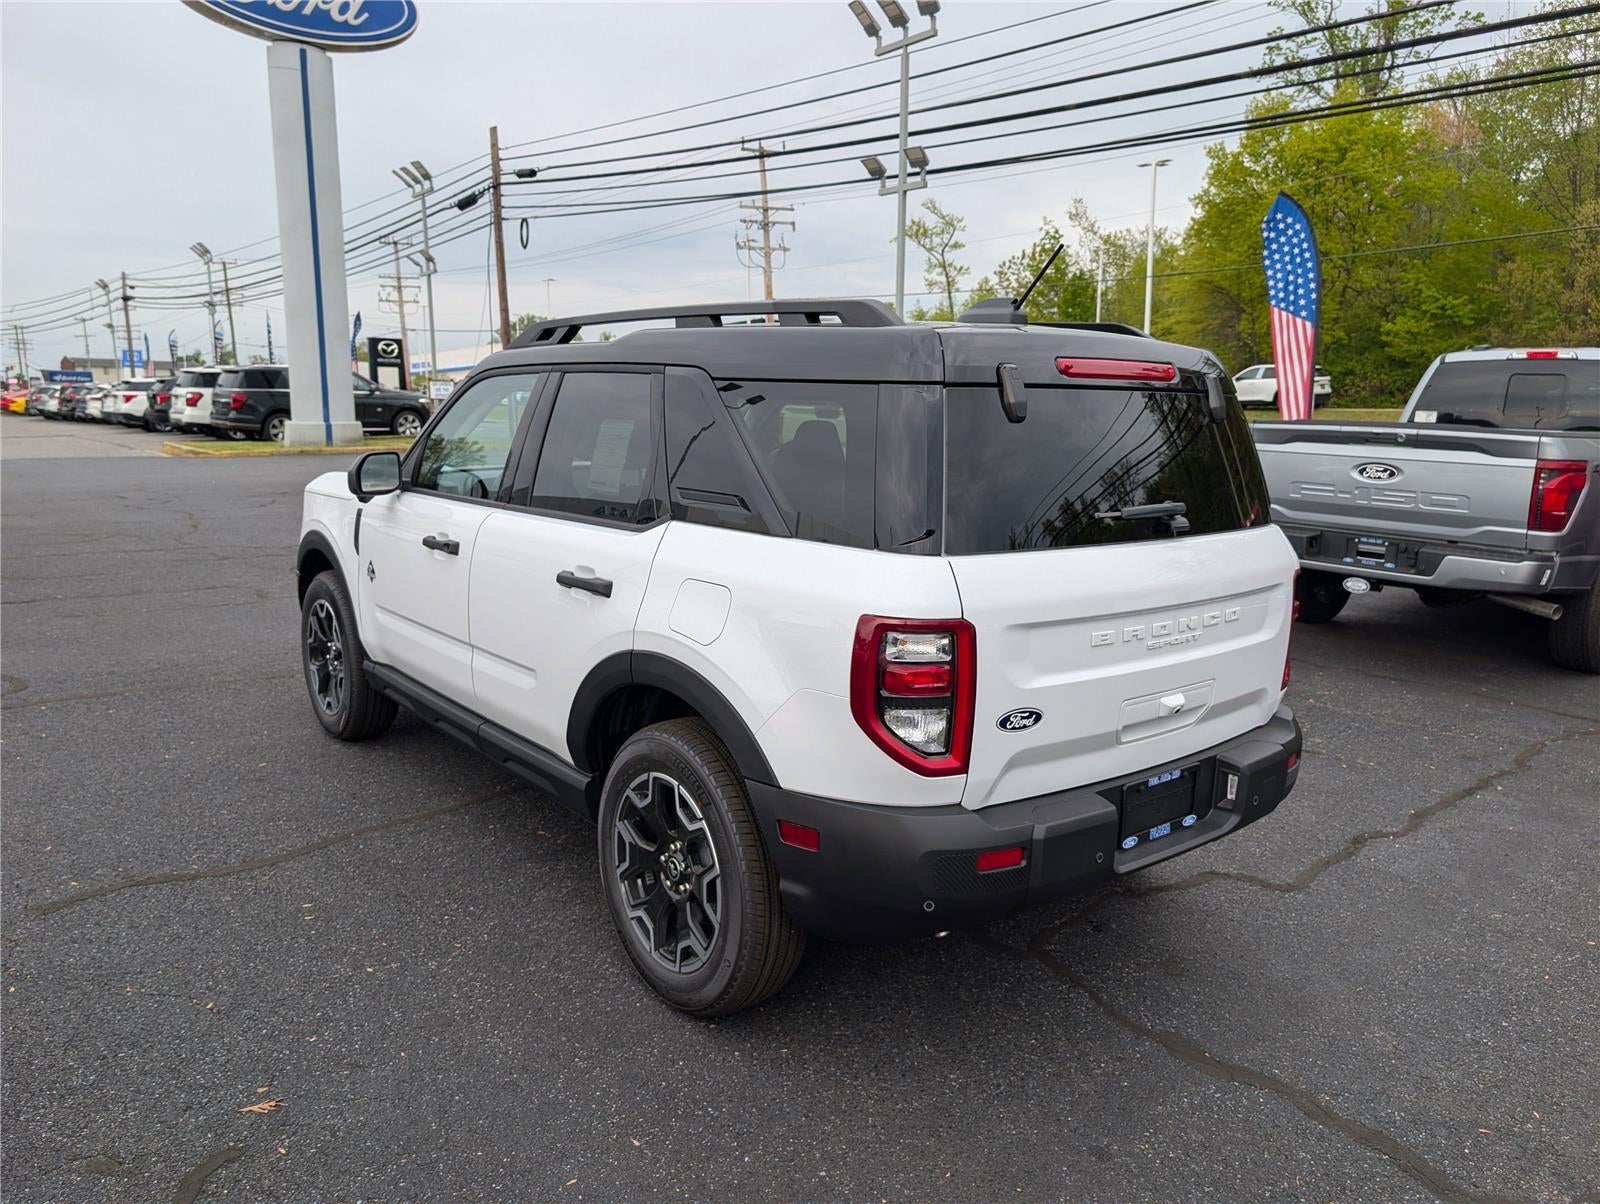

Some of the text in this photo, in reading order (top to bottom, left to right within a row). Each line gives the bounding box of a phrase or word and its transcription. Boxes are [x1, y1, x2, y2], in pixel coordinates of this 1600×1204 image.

[1362, 464, 1391, 480] Ford
[1289, 480, 1472, 514] F-150
[1090, 606, 1241, 648] BRONCO
[1146, 631, 1203, 651] SPORT
[1006, 712, 1036, 730] Ford
